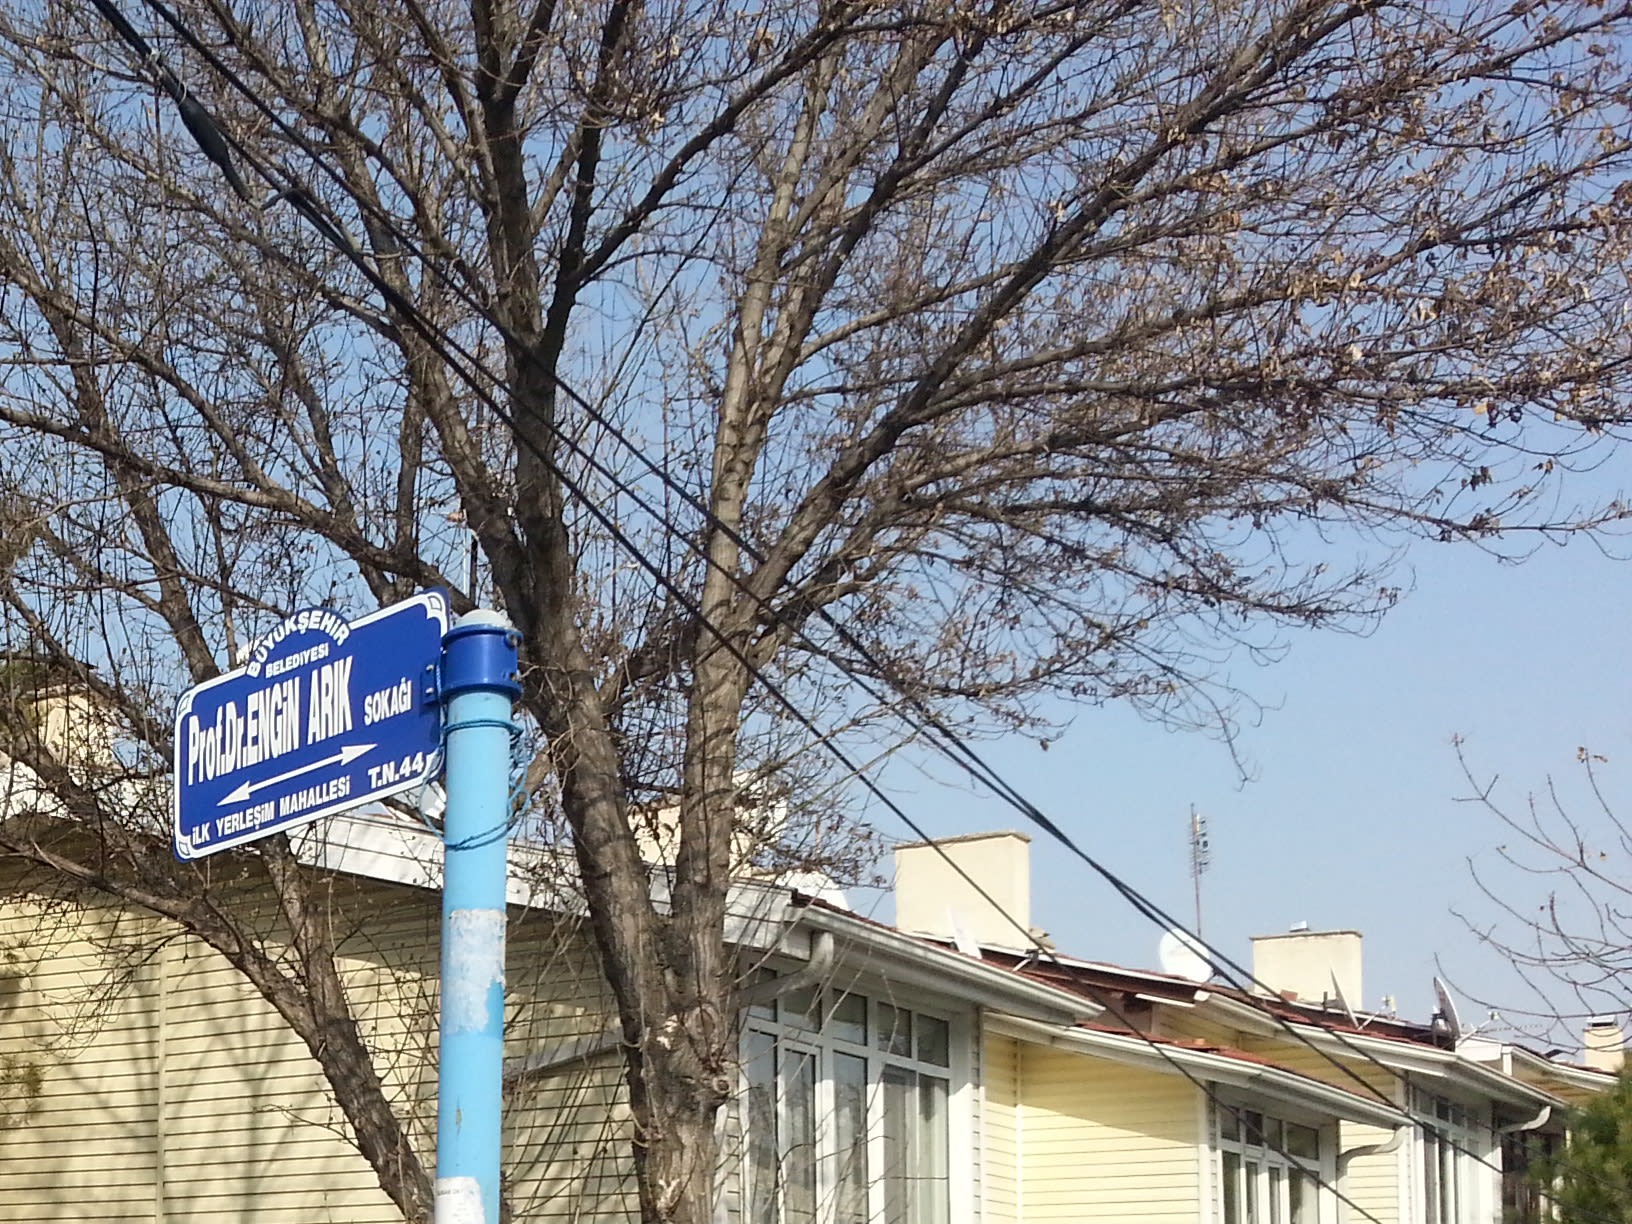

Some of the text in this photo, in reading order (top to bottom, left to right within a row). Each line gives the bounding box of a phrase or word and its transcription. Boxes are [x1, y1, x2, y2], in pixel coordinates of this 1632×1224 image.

[246, 610, 351, 678] BÜYÜKŞEHİR
[307, 655, 354, 745] ARIK
[364, 677, 413, 726] SOKAĞI
[279, 775, 351, 818] MAHALLESİ
[368, 752, 425, 789] T.N.44
